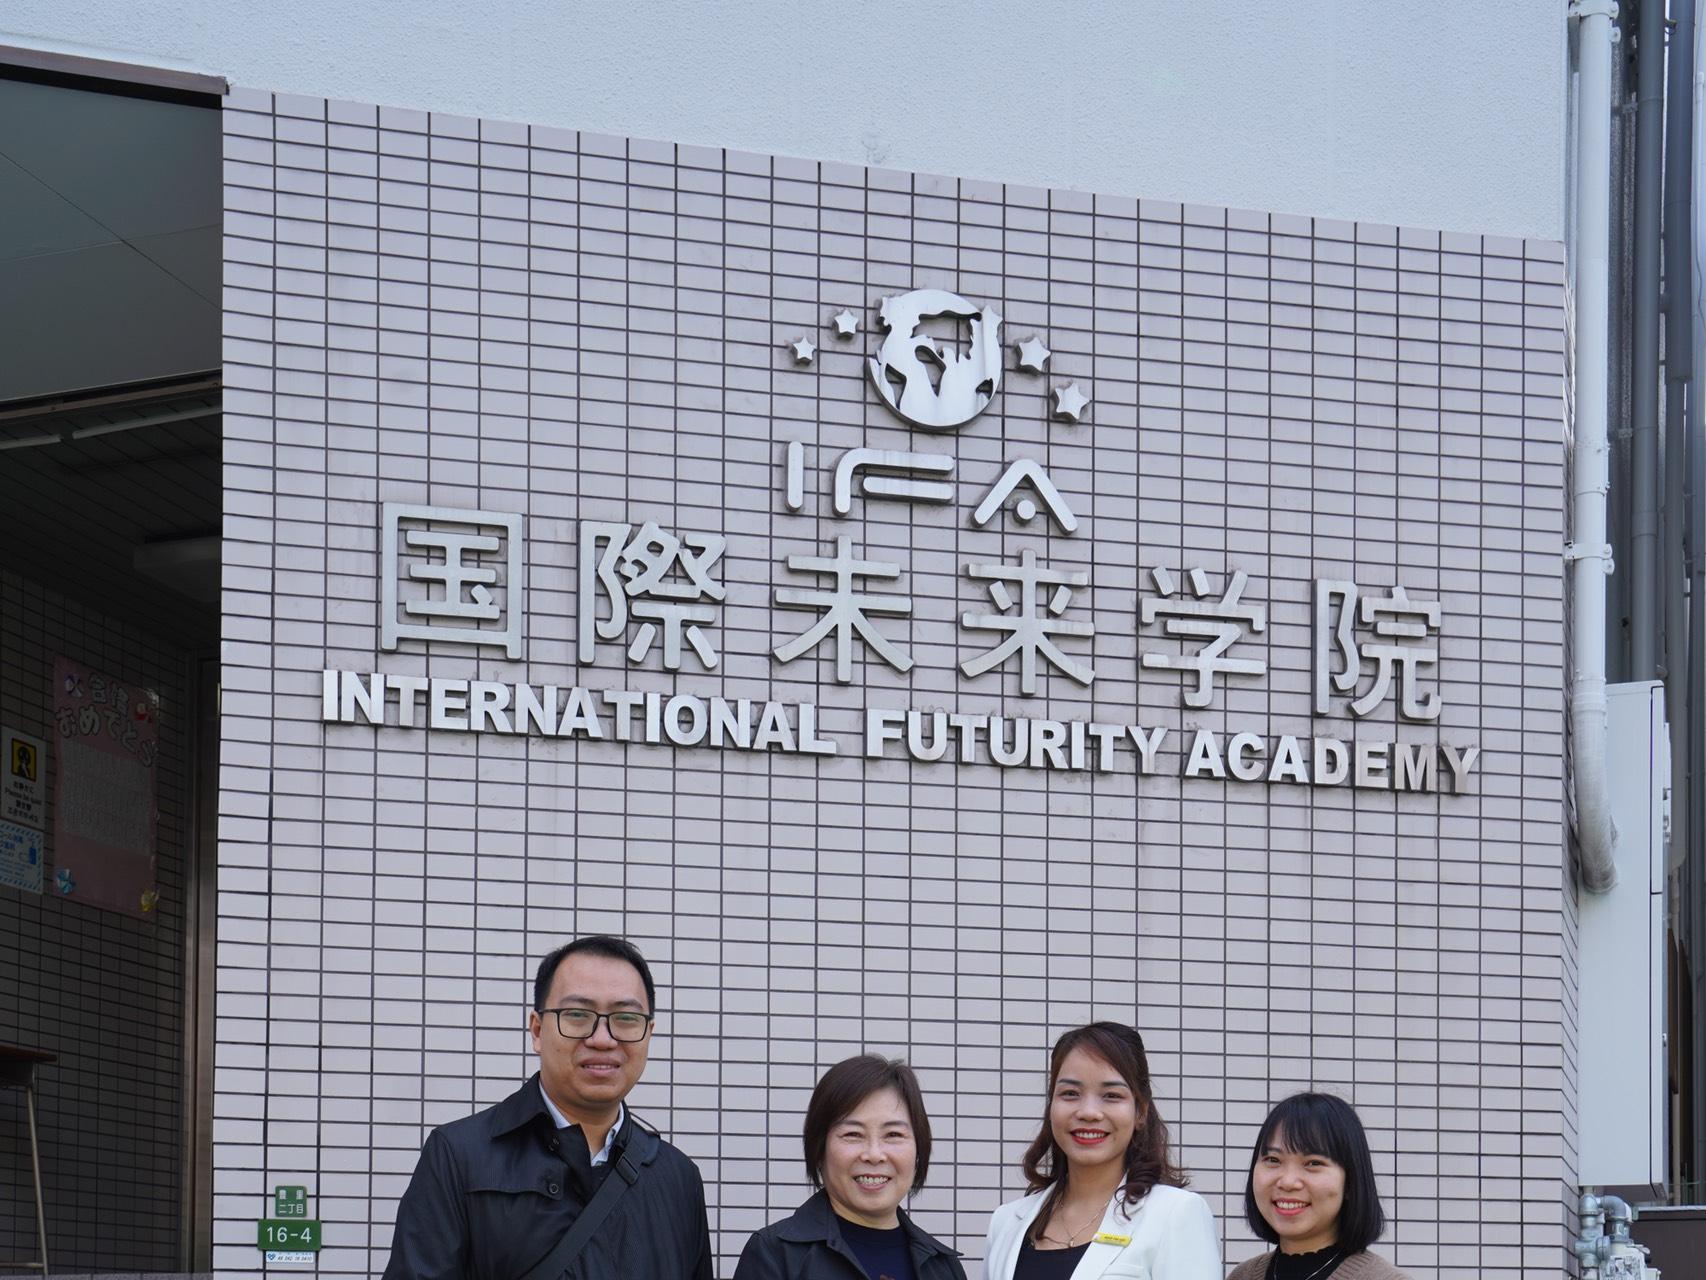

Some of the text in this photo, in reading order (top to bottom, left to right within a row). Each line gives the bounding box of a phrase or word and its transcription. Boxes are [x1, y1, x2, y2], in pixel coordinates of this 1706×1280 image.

[380, 501, 1442, 720] 国際未来学院
[322, 669, 1481, 796] INTERNATIONAL FUTURITY ACADEMY
[266, 1226, 312, 1243] 16-4
[279, 1203, 304, 1214] 二丁目
